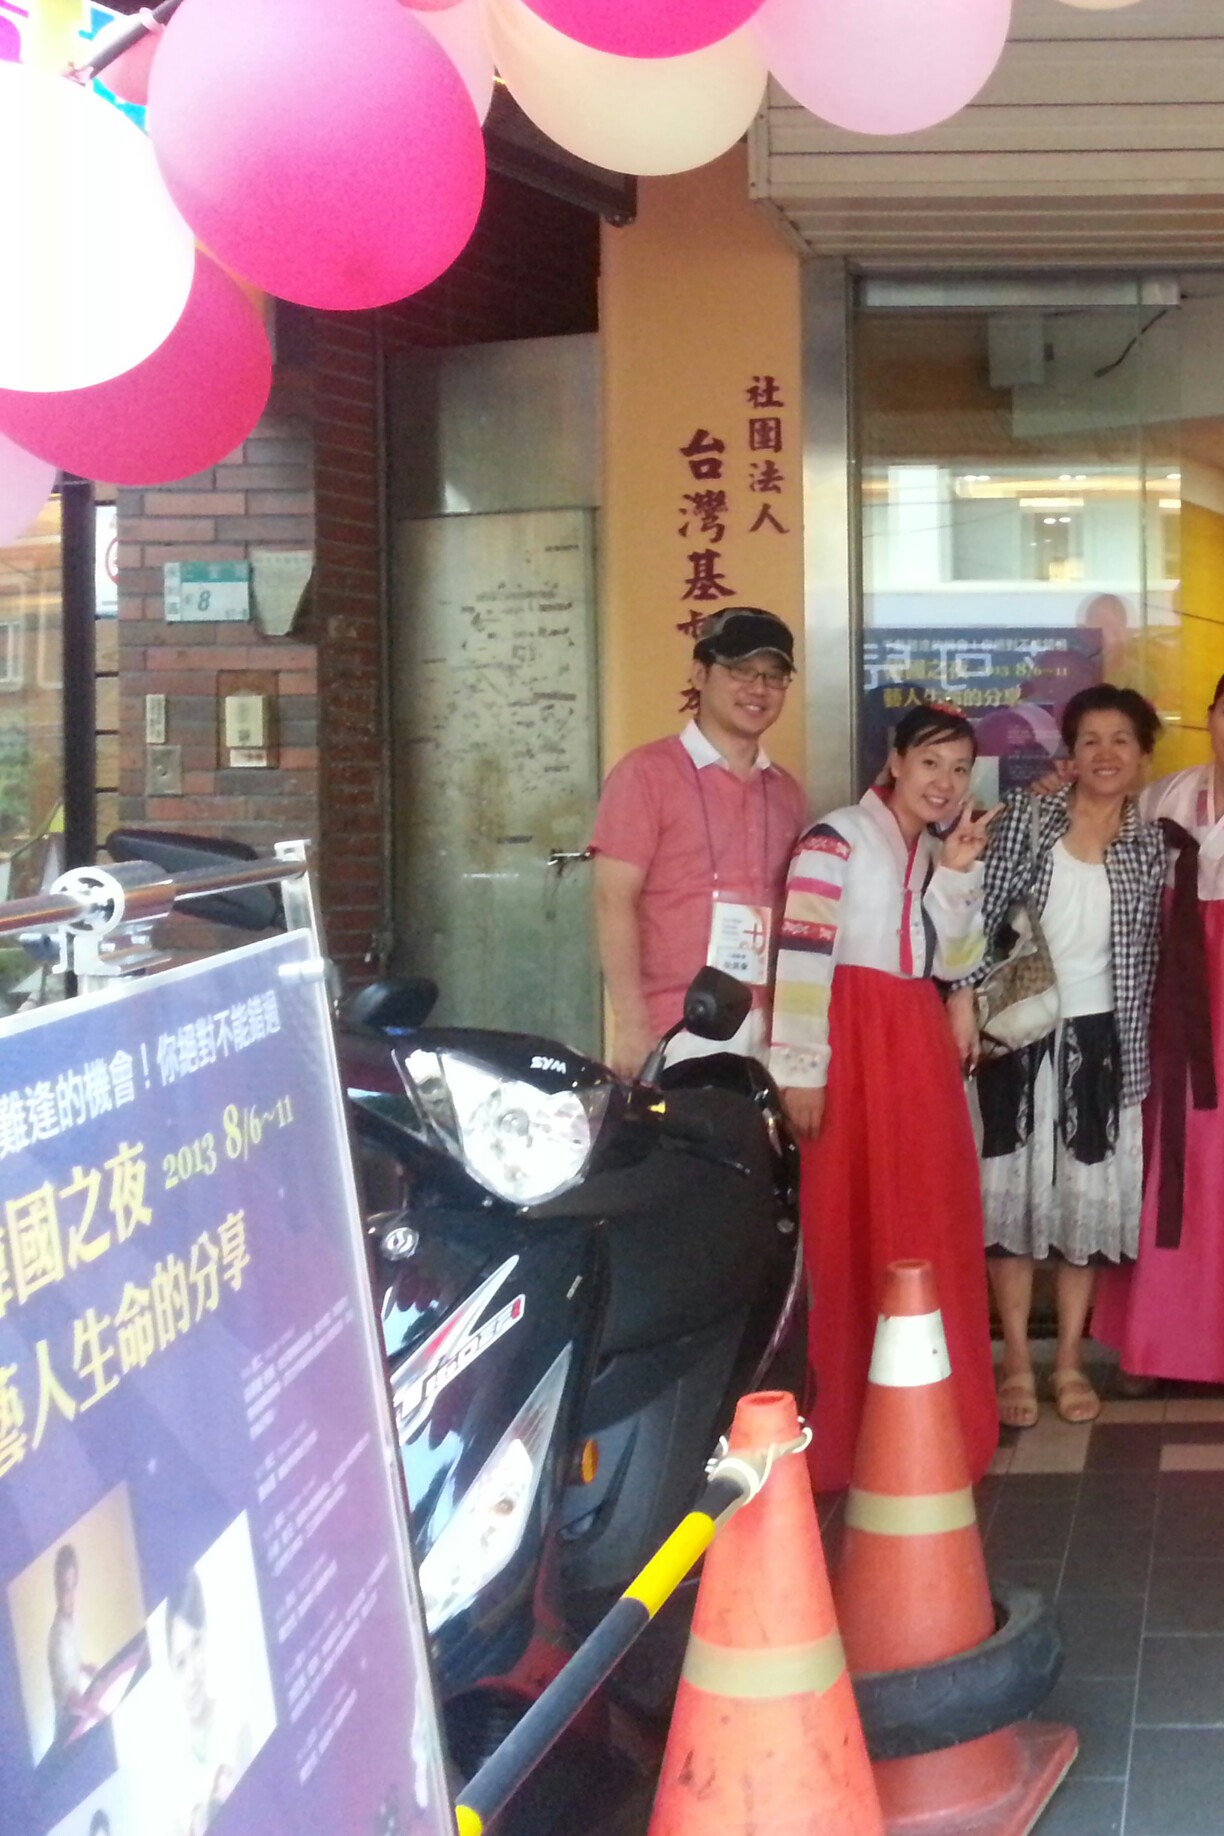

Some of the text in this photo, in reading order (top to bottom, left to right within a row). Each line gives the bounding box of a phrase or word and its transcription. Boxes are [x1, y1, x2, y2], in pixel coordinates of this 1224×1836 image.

[747, 376, 790, 534] 社團法人
[677, 429, 736, 720] 台灣基
[530, 1056, 567, 1075] SYM
[0, 1141, 152, 1319] 國之夜
[163, 1132, 217, 1189] 2013
